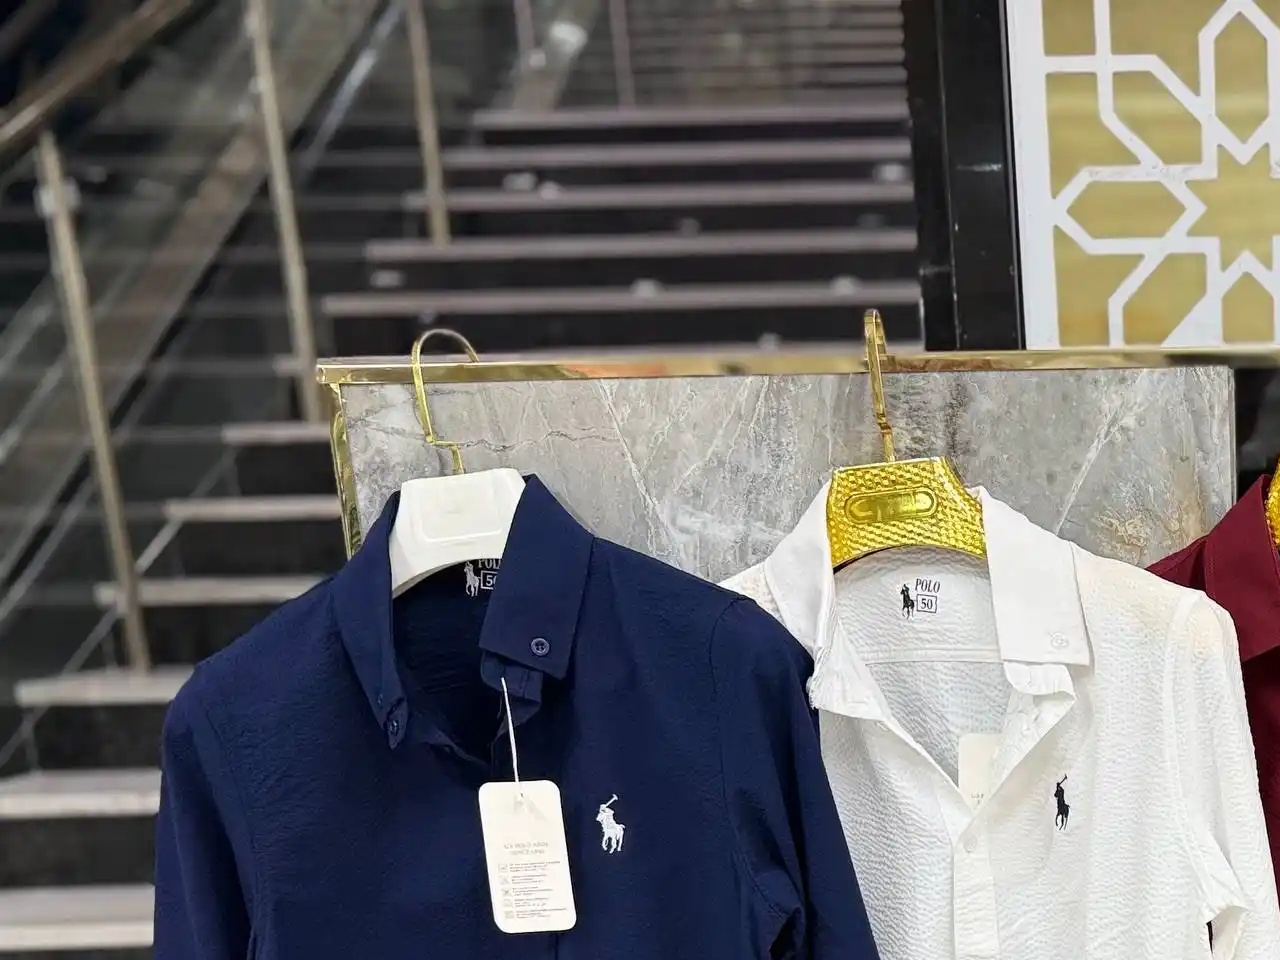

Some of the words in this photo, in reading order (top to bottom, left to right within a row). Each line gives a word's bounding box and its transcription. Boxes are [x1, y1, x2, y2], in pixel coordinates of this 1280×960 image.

[478, 559, 500, 569] POL
[915, 577, 941, 593] POLO
[920, 597, 933, 610] 50
